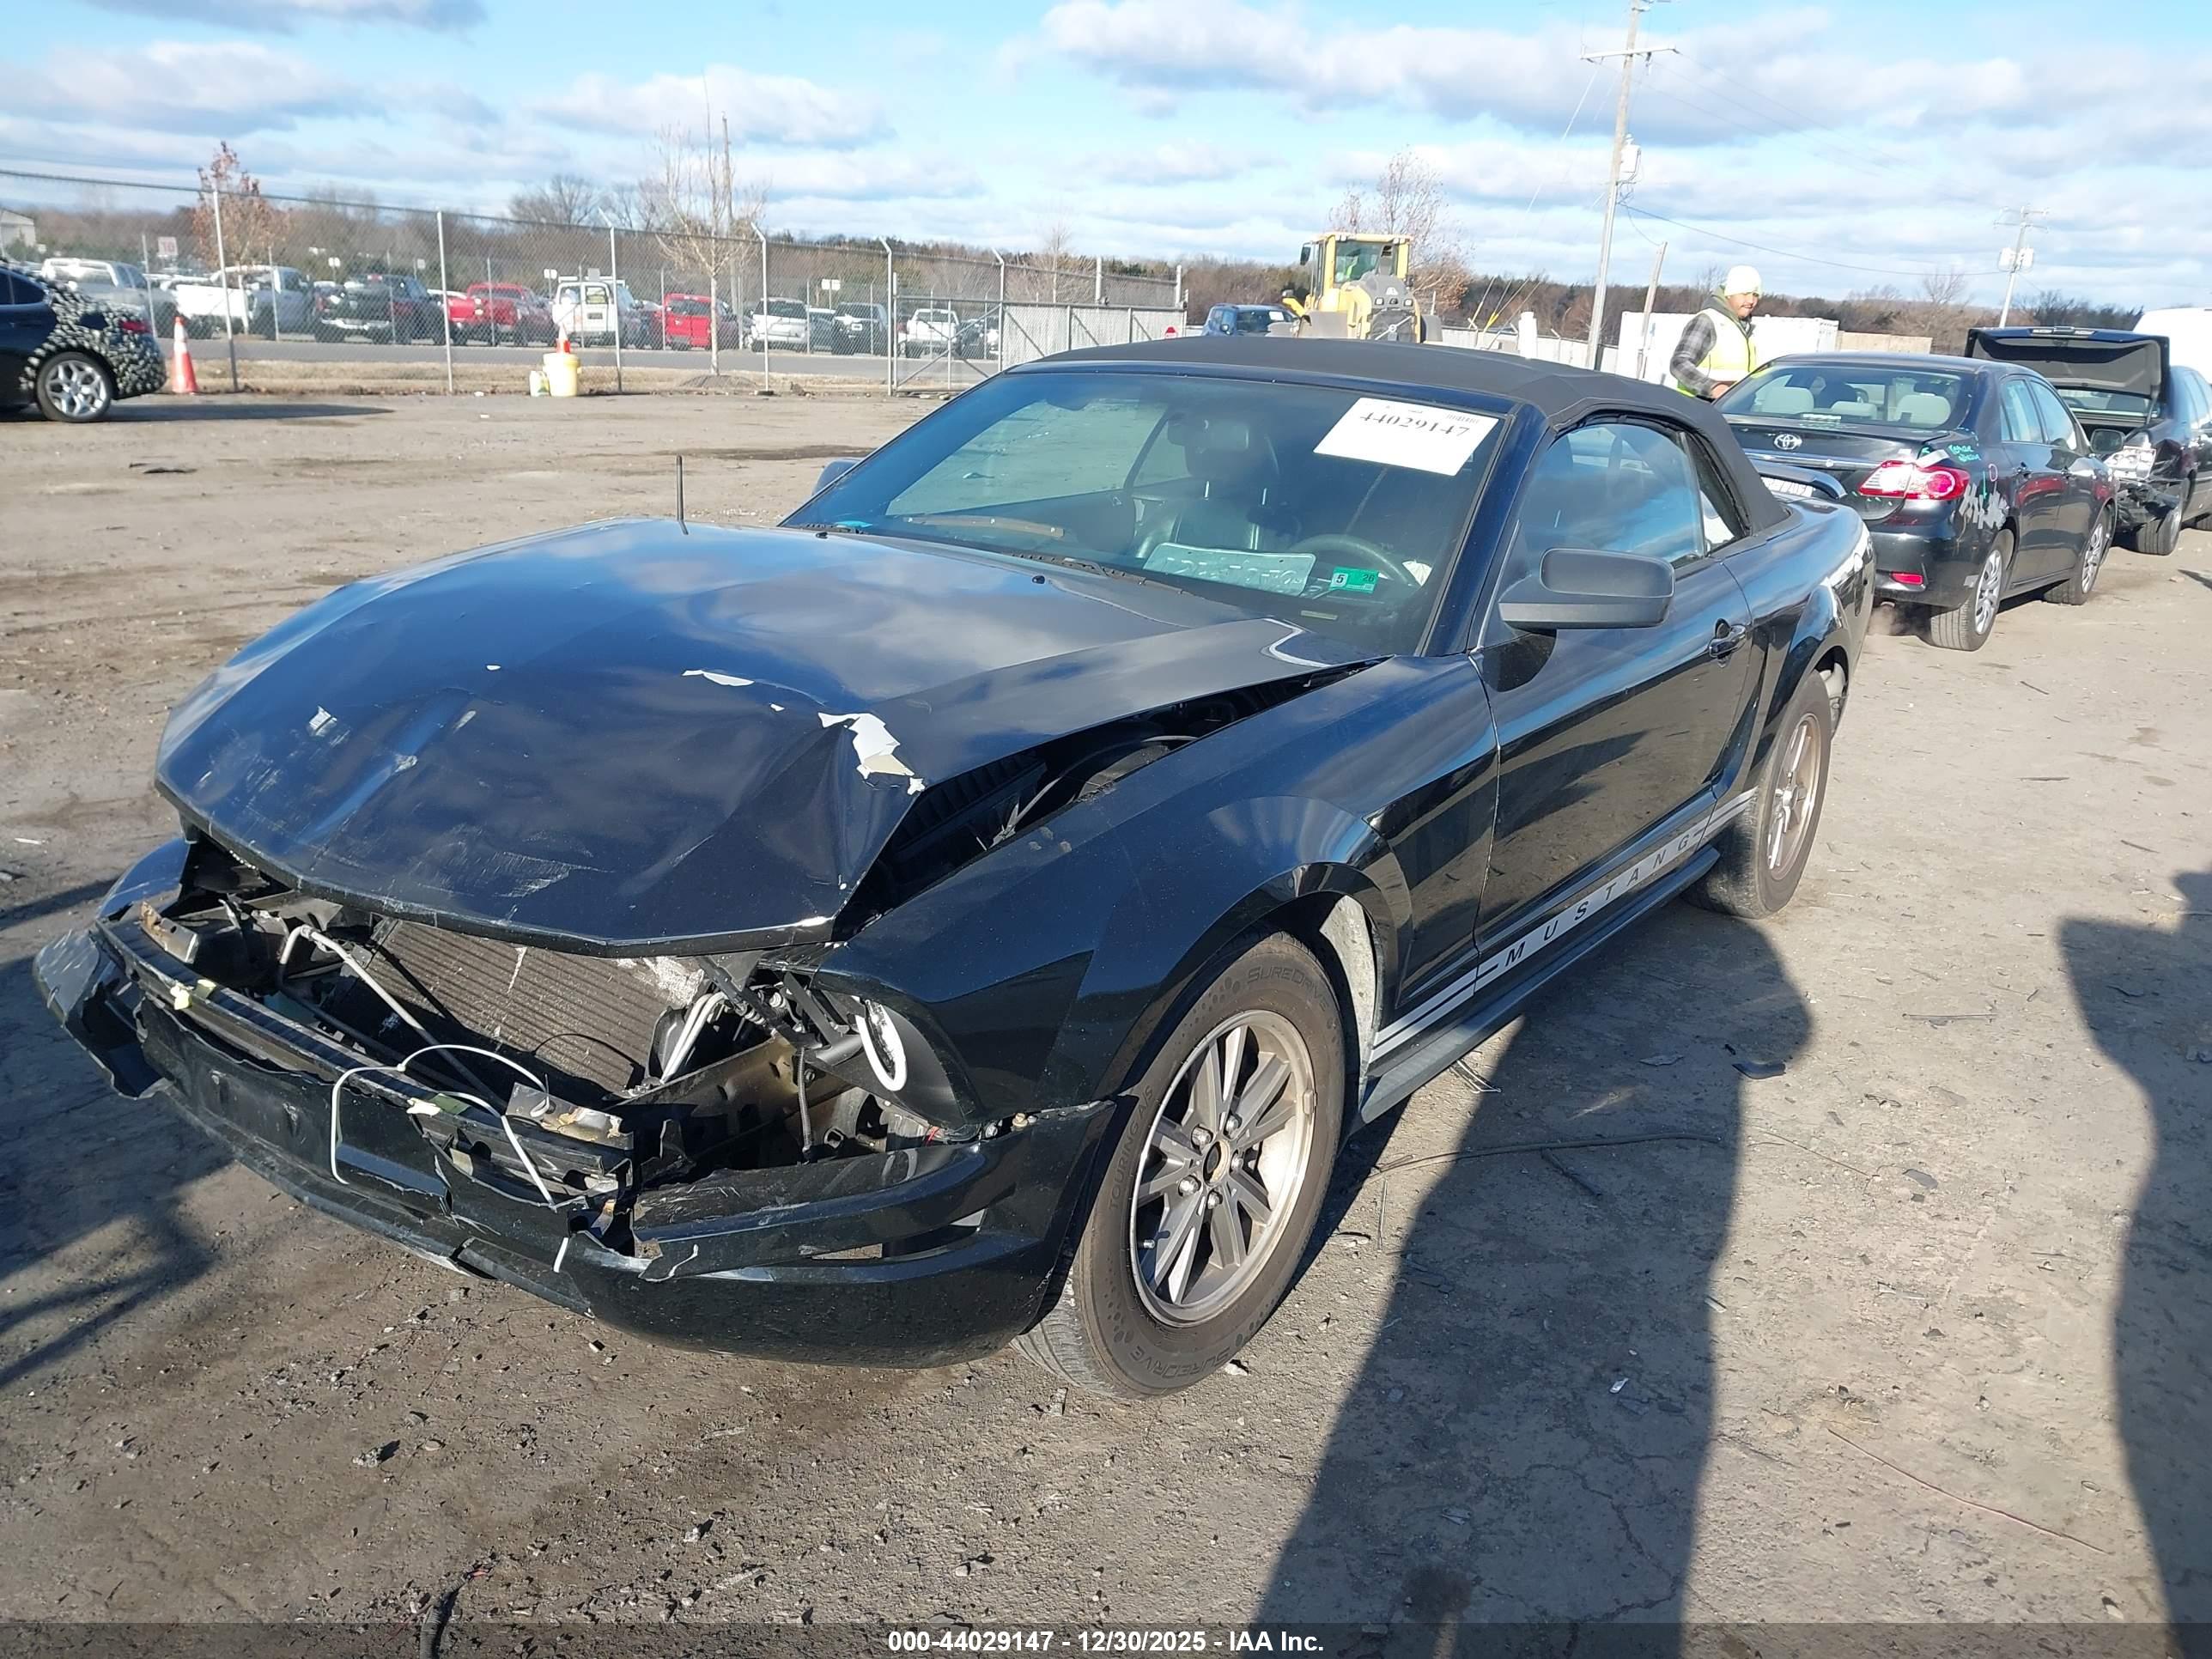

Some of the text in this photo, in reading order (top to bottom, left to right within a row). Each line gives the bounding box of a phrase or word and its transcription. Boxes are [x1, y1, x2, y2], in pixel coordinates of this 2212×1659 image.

[1360, 412, 1470, 436] 44029147
[1336, 574, 1346, 584] 5
[1362, 574, 1375, 582] 26
[1504, 835, 1690, 967] MUSTANG
[1109, 1121, 1139, 1211] TOURING
